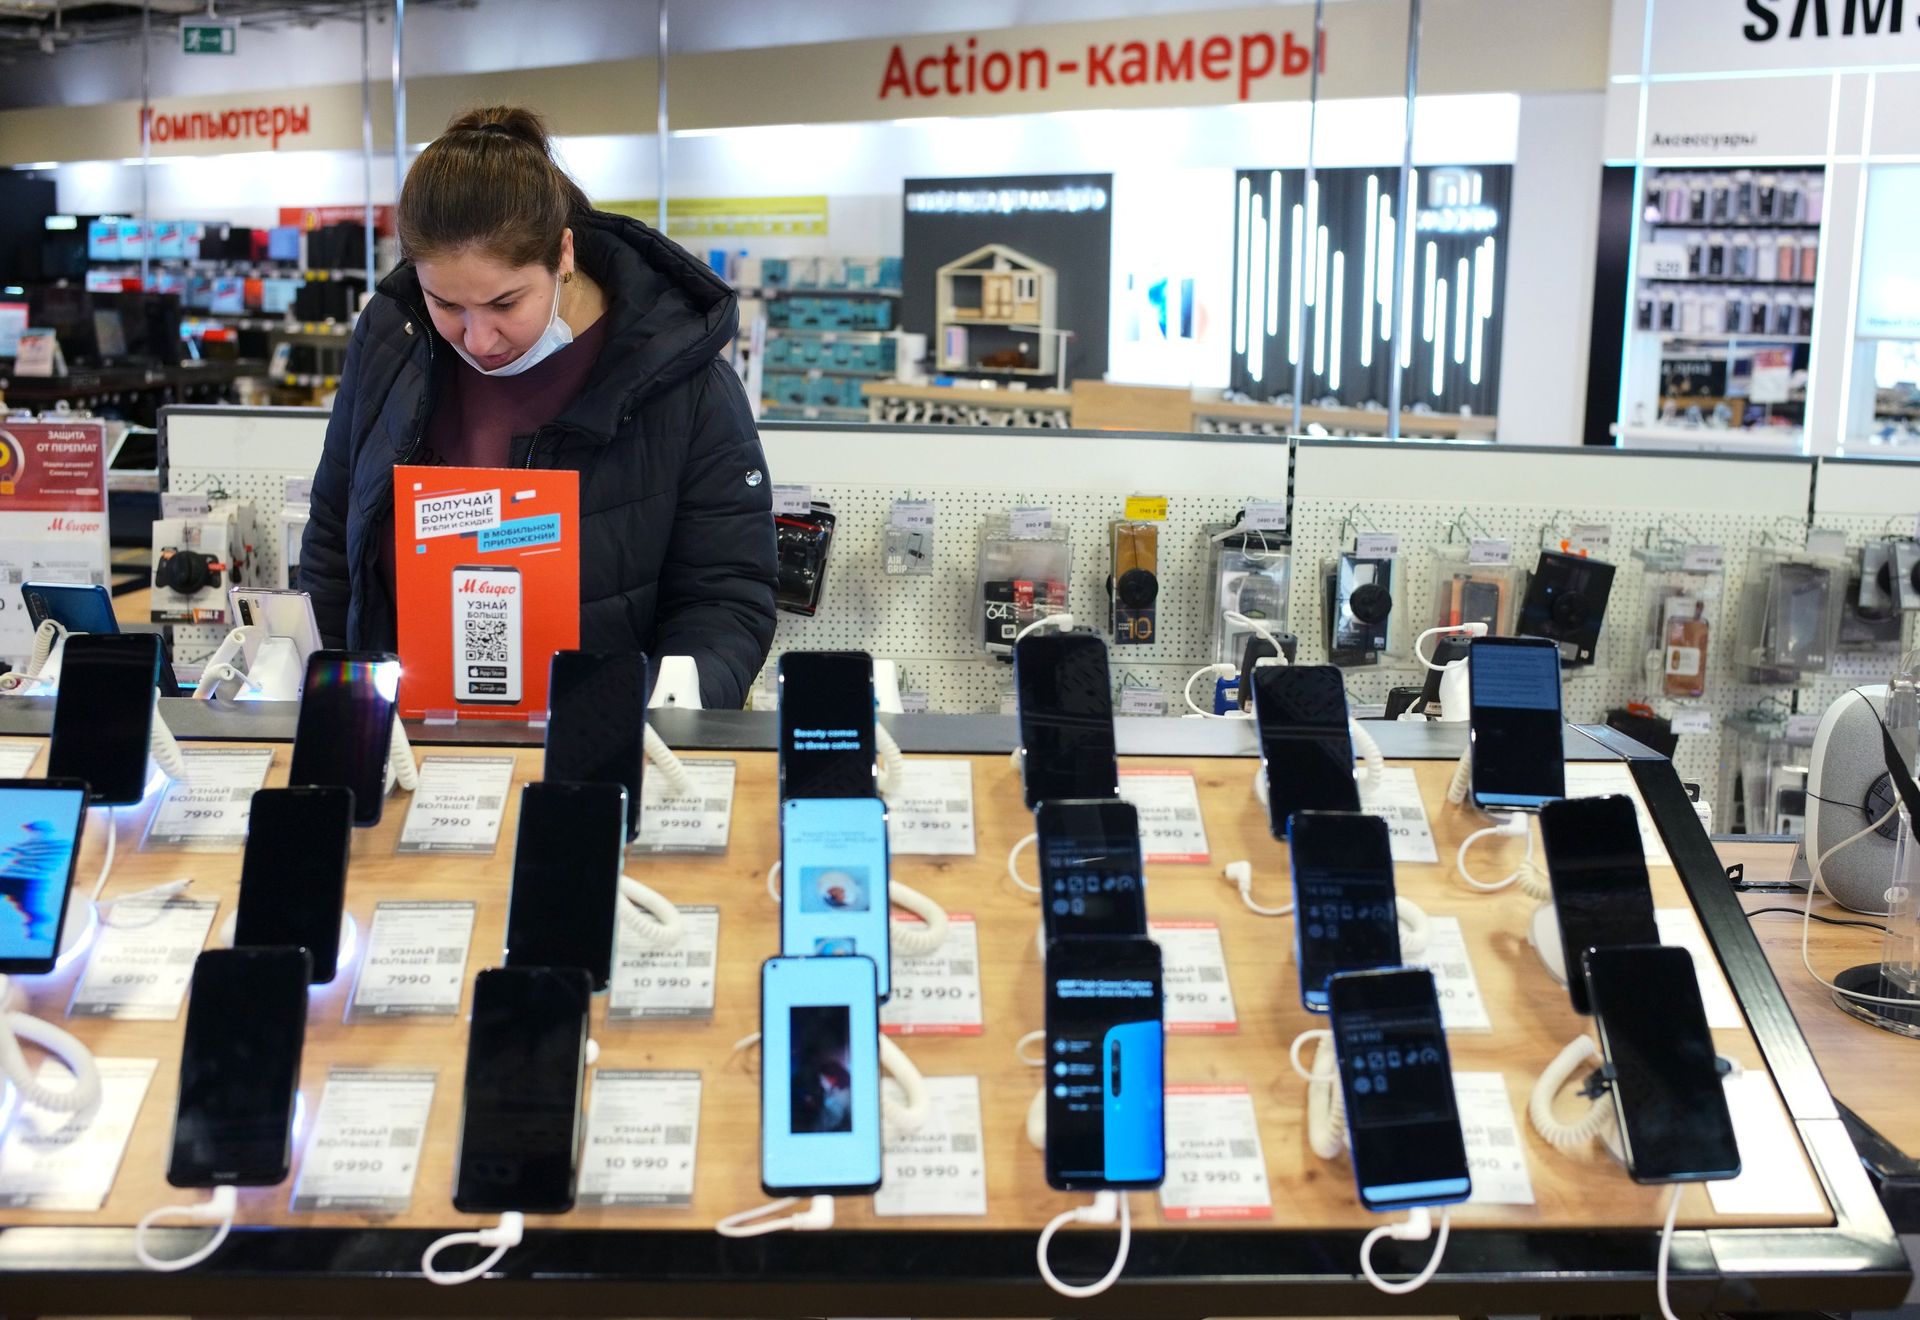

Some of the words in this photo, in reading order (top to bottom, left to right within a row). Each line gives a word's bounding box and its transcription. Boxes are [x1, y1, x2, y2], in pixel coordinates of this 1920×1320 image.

[1743, 0, 1920, 42] SAM
[879, 28, 1326, 101] Action-камеры
[139, 104, 311, 151] Компьютеры
[47, 430, 86, 442] ЗАЩИТА
[36, 443, 49, 453] ОТ
[51, 443, 98, 453] ПЕРЕПЛАТ
[421, 492, 494, 514] ПОЛУЧАЙ
[421, 506, 494, 525] БОНУСНЫЕ
[421, 522, 451, 533] РУБЛИ
[459, 517, 494, 529] СКИДКИ
[492, 523, 556, 538] МОБИЛЬНОМ
[483, 531, 556, 549] ПРИЛОЖЕНИИ
[887, 555, 902, 565] AIR
[887, 564, 907, 574] GRIP
[467, 599, 508, 611] УЗНАЙ
[793, 728, 827, 739] Beauty
[827, 729, 858, 738] comes
[794, 741, 804, 750] in
[805, 741, 829, 750] three
[831, 741, 860, 750] colors
[183, 810, 224, 819] 7990
[431, 817, 471, 827] 7990
[660, 819, 702, 828] 9990
[901, 821, 916, 830] 12
[921, 821, 952, 830] 990
[112, 975, 159, 985] 6990
[386, 974, 431, 985] 7990
[633, 977, 652, 988] 10
[657, 977, 691, 988] 990
[894, 986, 913, 999] 12
[920, 986, 962, 998] 990
[333, 1159, 384, 1172] 9990
[605, 1157, 626, 1169] 10
[632, 1156, 669, 1169] 990
[896, 1165, 917, 1178] 10
[922, 1165, 959, 1177] 990
[1182, 1170, 1198, 1182] 12
[1204, 1170, 1241, 1182] 990
